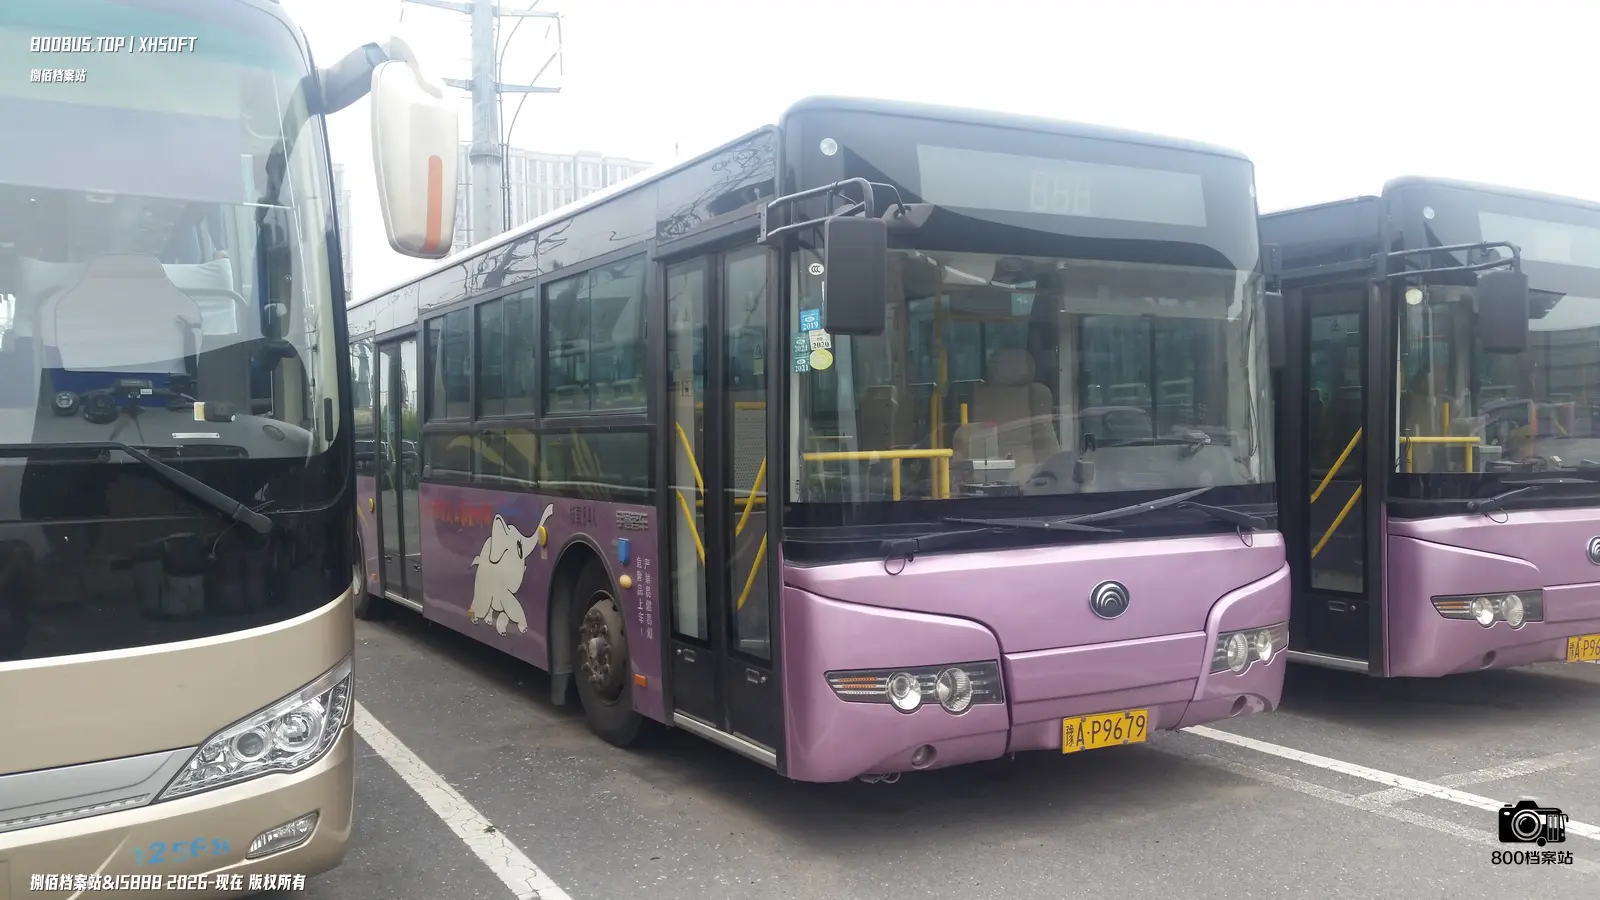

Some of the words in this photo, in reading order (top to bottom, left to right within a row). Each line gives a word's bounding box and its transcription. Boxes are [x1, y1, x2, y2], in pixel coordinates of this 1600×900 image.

[801, 321, 819, 331] 2019
[794, 344, 808, 353] 2021
[812, 341, 830, 350] 2020
[795, 364, 809, 373] 2021
